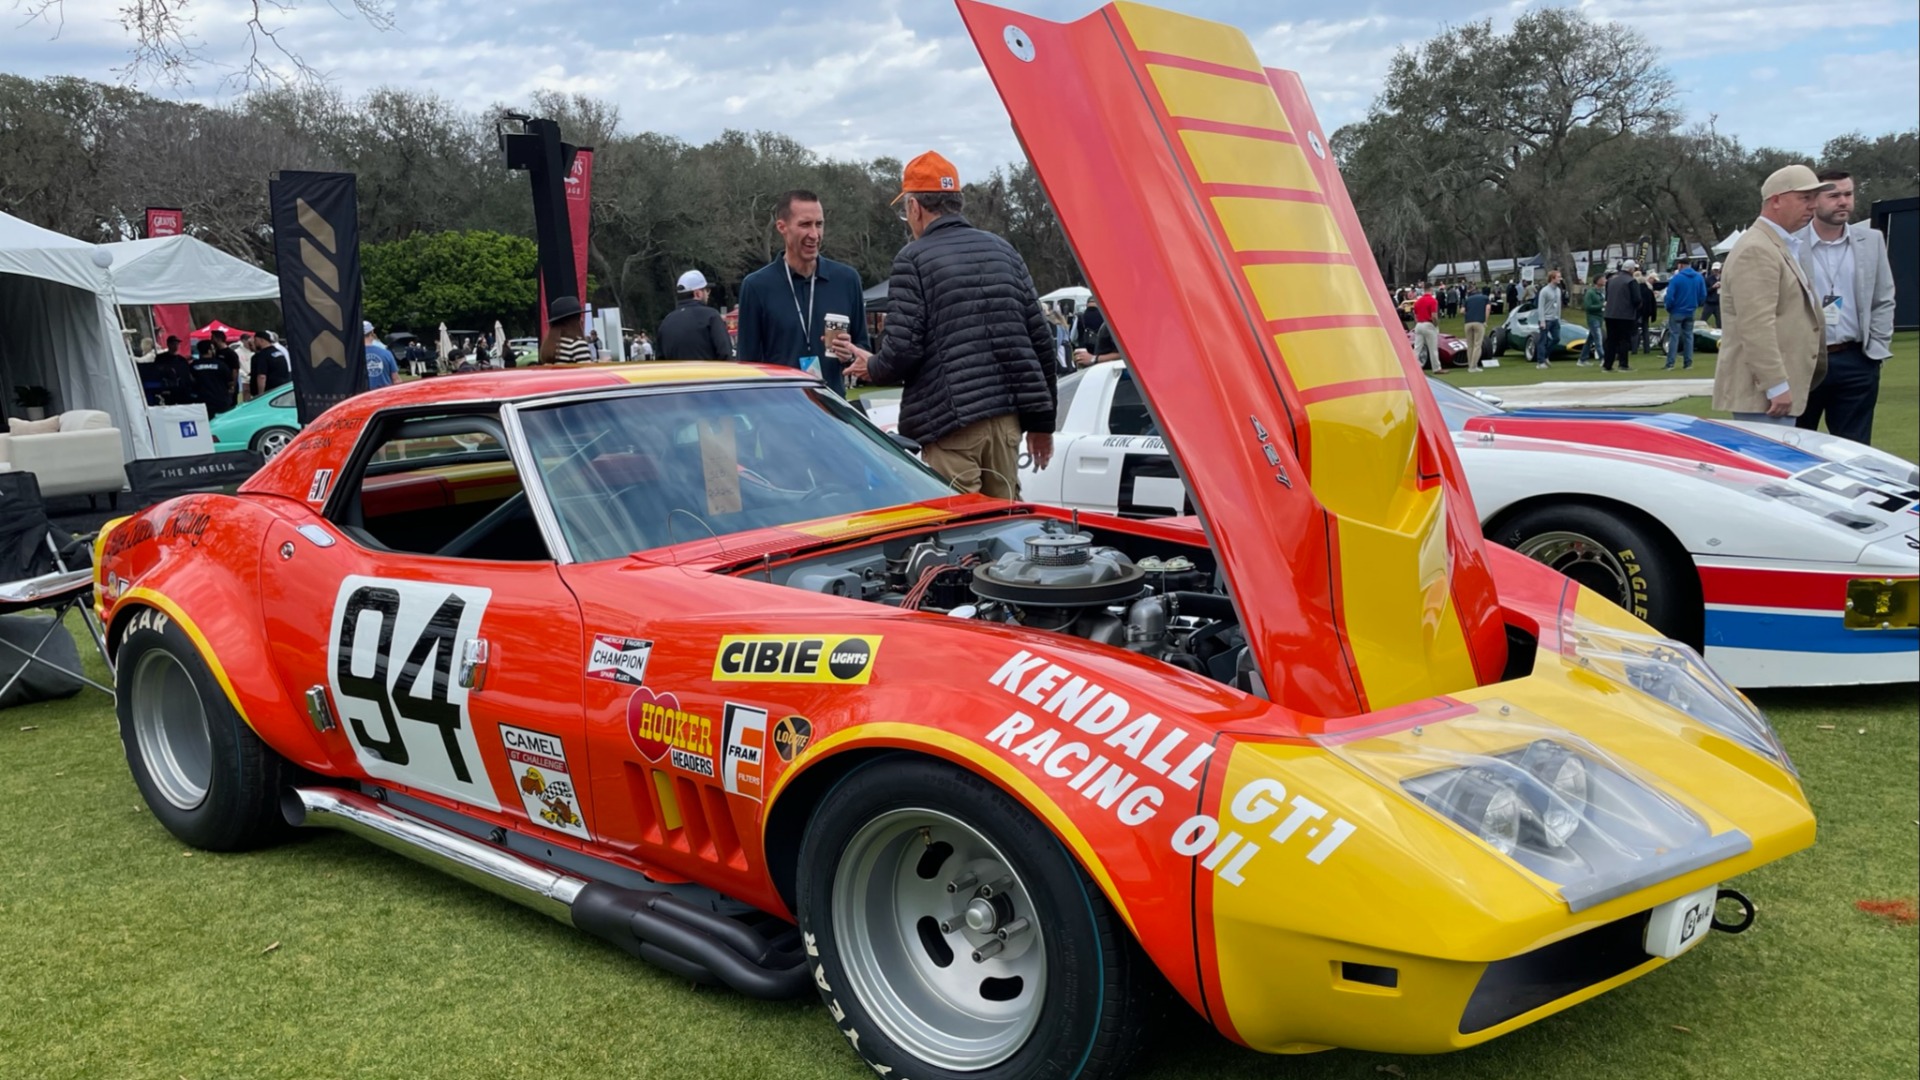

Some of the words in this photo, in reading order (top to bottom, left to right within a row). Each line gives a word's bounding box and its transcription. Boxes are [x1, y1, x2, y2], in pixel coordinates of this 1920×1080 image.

[942, 177, 953, 188] 94
[1250, 414, 1293, 489] 427
[161, 468, 184, 478] THE
[189, 463, 235, 475] AMELIA
[1618, 549, 1648, 620] EAGLE
[593, 650, 645, 670] CHAMPION
[830, 653, 869, 665] LIGHTS
[338, 585, 473, 784] 94
[600, 671, 615, 679] SPARK
[616, 674, 630, 682] PLUGS
[638, 702, 713, 757] HOOKER
[988, 650, 1216, 791] KENDALL
[505, 730, 562, 758] CAMEL
[728, 745, 757, 761] FRAM
[510, 752, 520, 760] GT
[522, 754, 564, 771] CHALLENGE
[672, 750, 713, 776] HEADERS
[738, 773, 760, 786] FILTERS
[985, 711, 1165, 827] RACING
[1170, 814, 1261, 887] OIL
